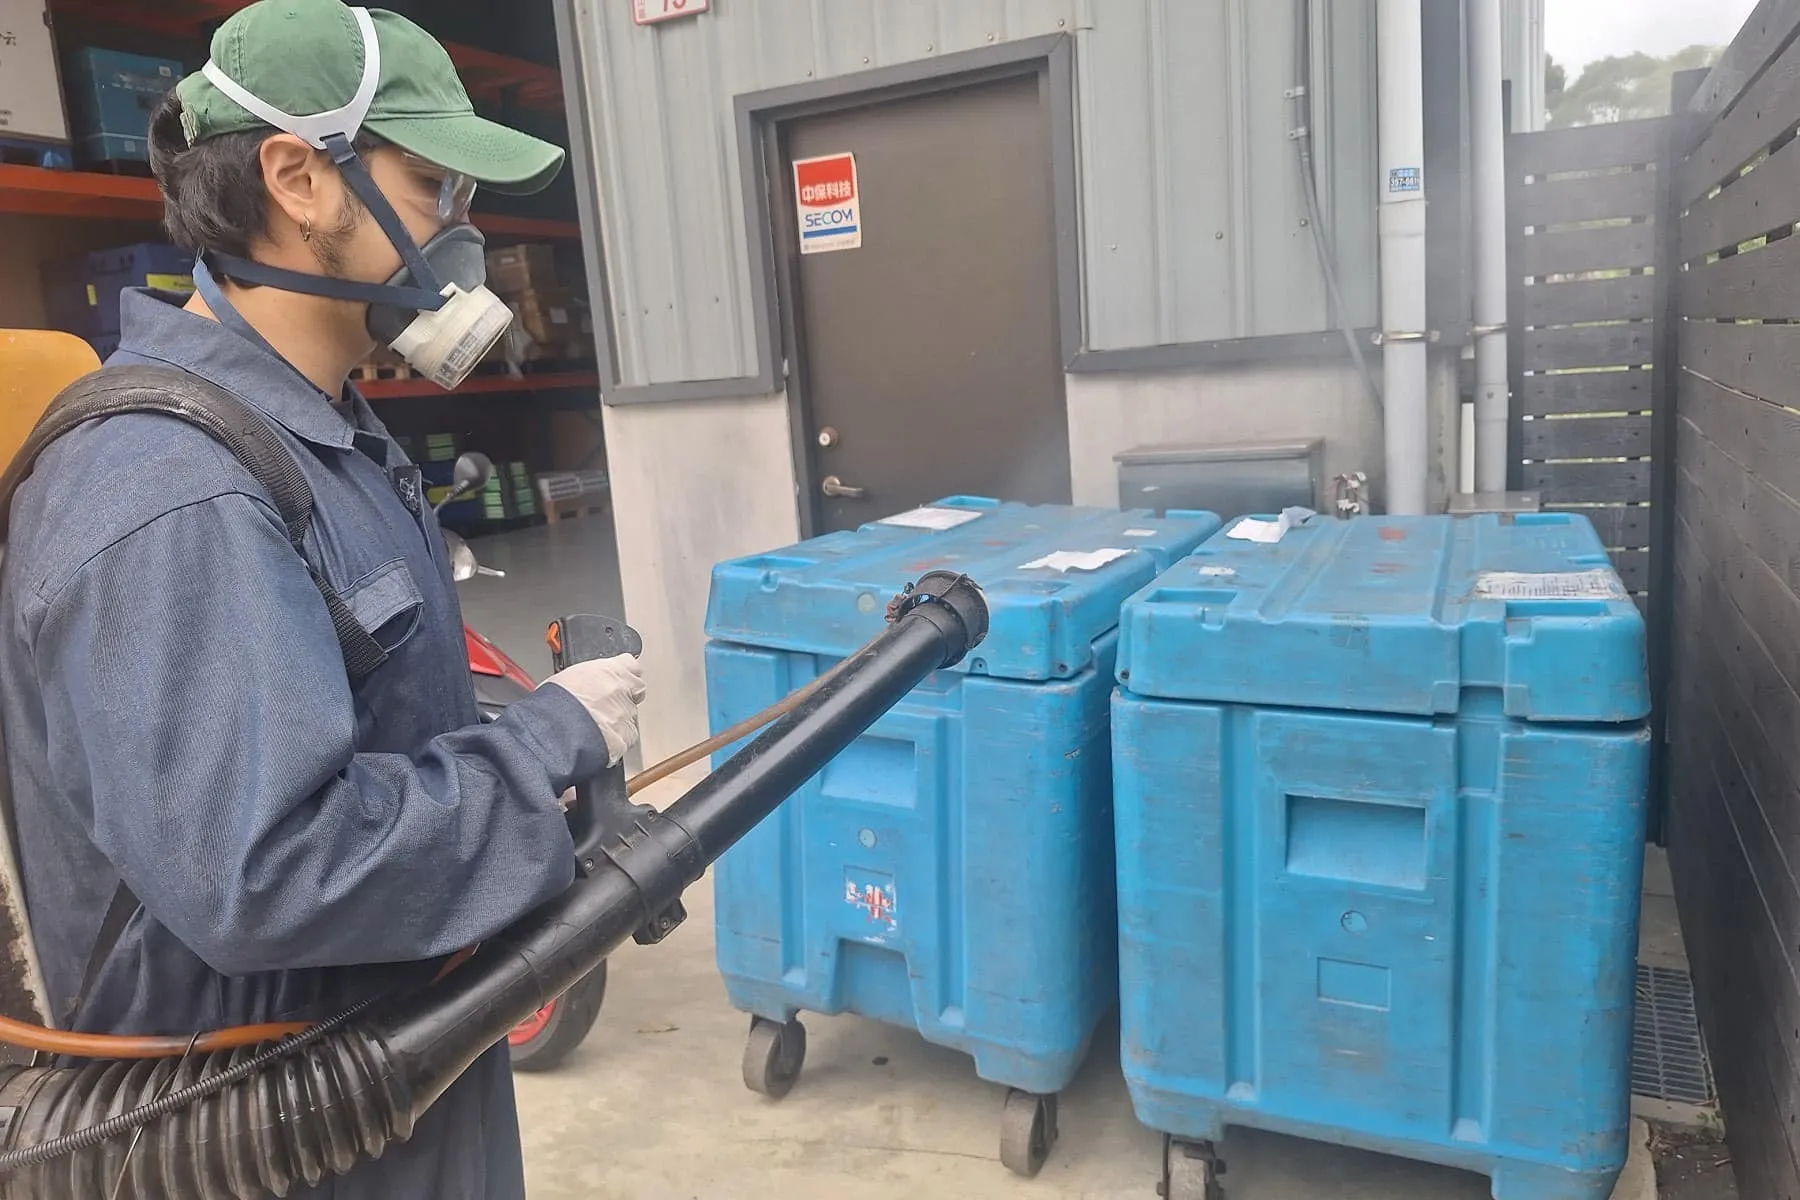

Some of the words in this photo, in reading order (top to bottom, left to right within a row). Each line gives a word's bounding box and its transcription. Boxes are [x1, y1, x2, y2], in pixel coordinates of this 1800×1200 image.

[801, 179, 852, 202] 中保科技
[805, 208, 853, 227] SECOM
